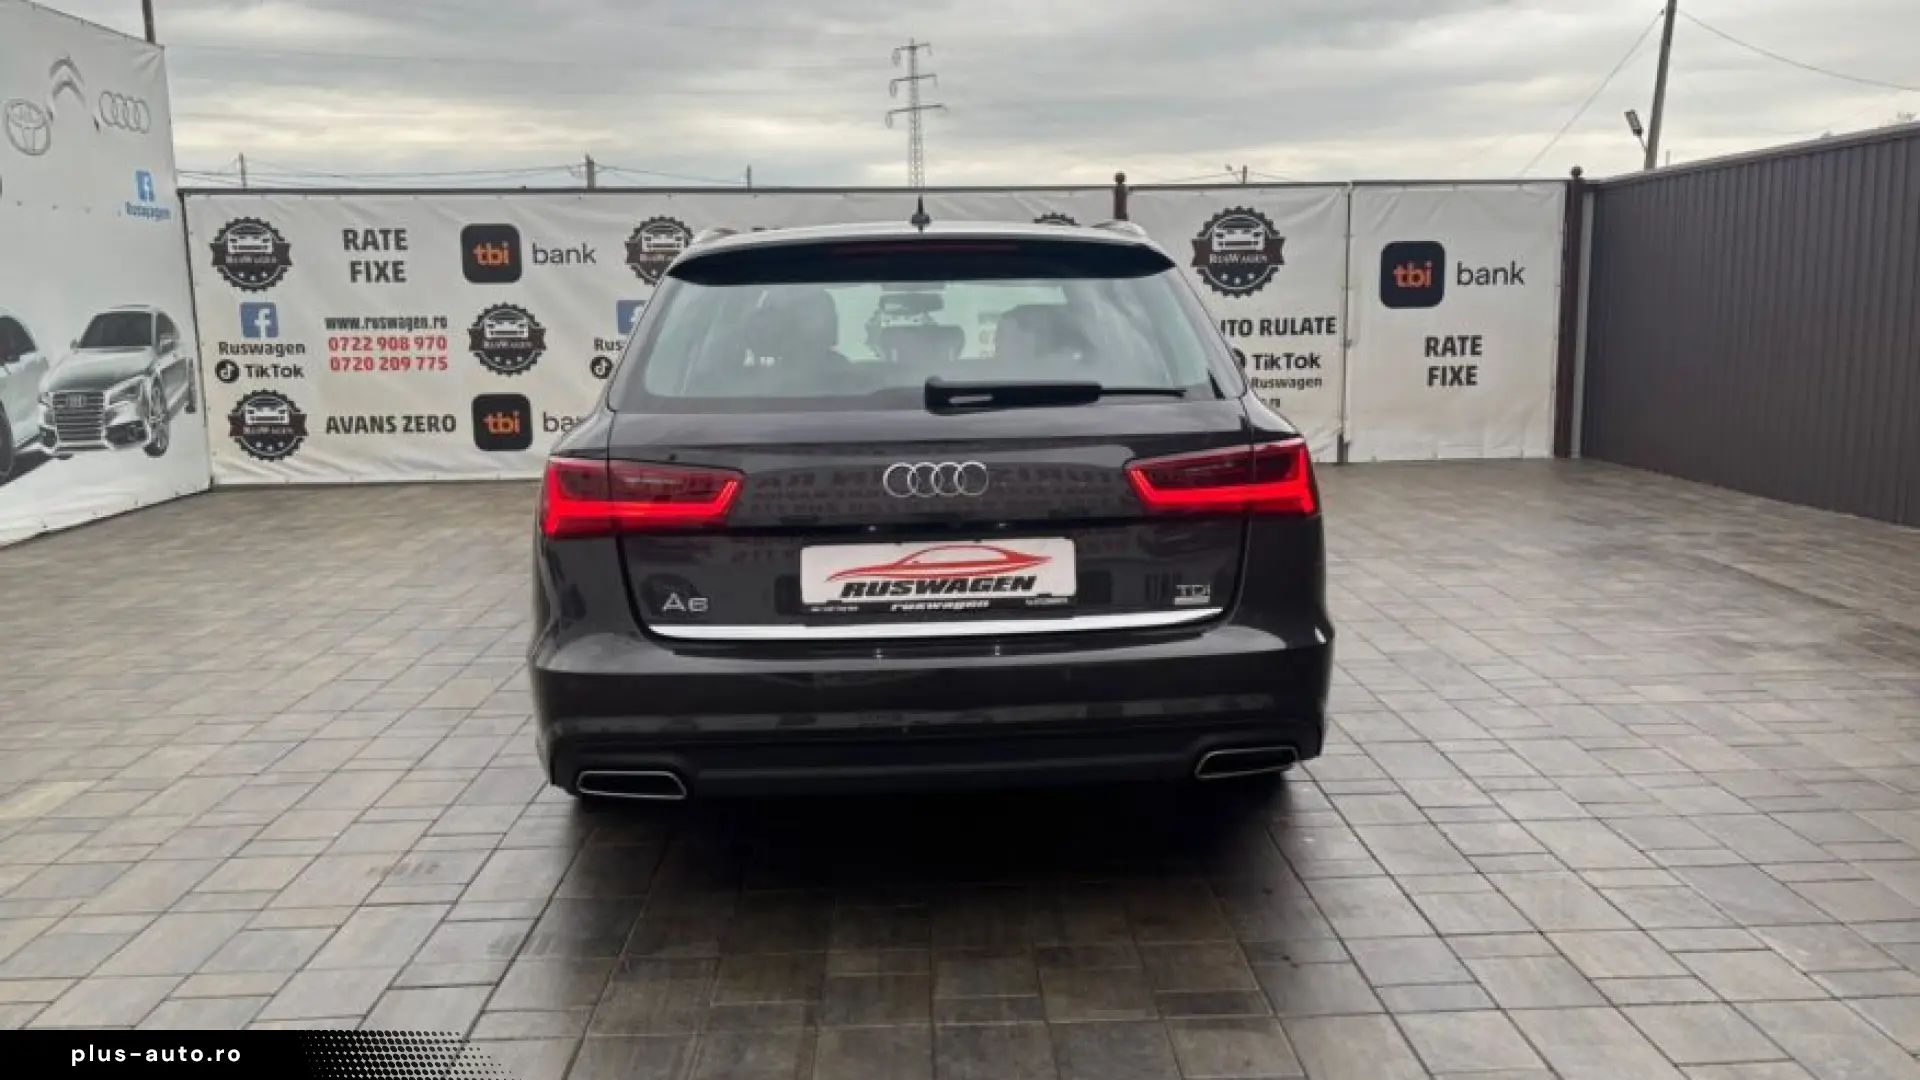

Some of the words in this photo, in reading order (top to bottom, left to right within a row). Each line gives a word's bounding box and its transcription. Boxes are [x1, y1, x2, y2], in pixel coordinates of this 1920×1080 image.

[343, 228, 408, 251] RATE
[473, 241, 509, 265] tbi
[532, 240, 597, 264] bank
[350, 261, 407, 283] FIXE
[1394, 261, 1433, 288] tbi
[1457, 260, 1526, 286] bank
[325, 316, 448, 331] www.ruswagen.ro
[1260, 316, 1337, 336] RULATE
[218, 341, 306, 357] Ruswagen
[328, 336, 373, 351] 0722
[376, 336, 411, 351] 908
[414, 336, 448, 351] 970
[1424, 335, 1483, 358] RATE
[330, 356, 375, 371] 0720
[379, 356, 411, 371] 209
[414, 356, 448, 371] 775
[1252, 352, 1322, 370] TikTok
[244, 363, 305, 380] TikTok
[1427, 366, 1479, 387] FIXE
[326, 415, 397, 434] AVANS
[401, 414, 457, 433] ZERO
[484, 410, 520, 435] tbi
[840, 575, 1038, 599] RUSWAGEN
[662, 592, 709, 612] A6
